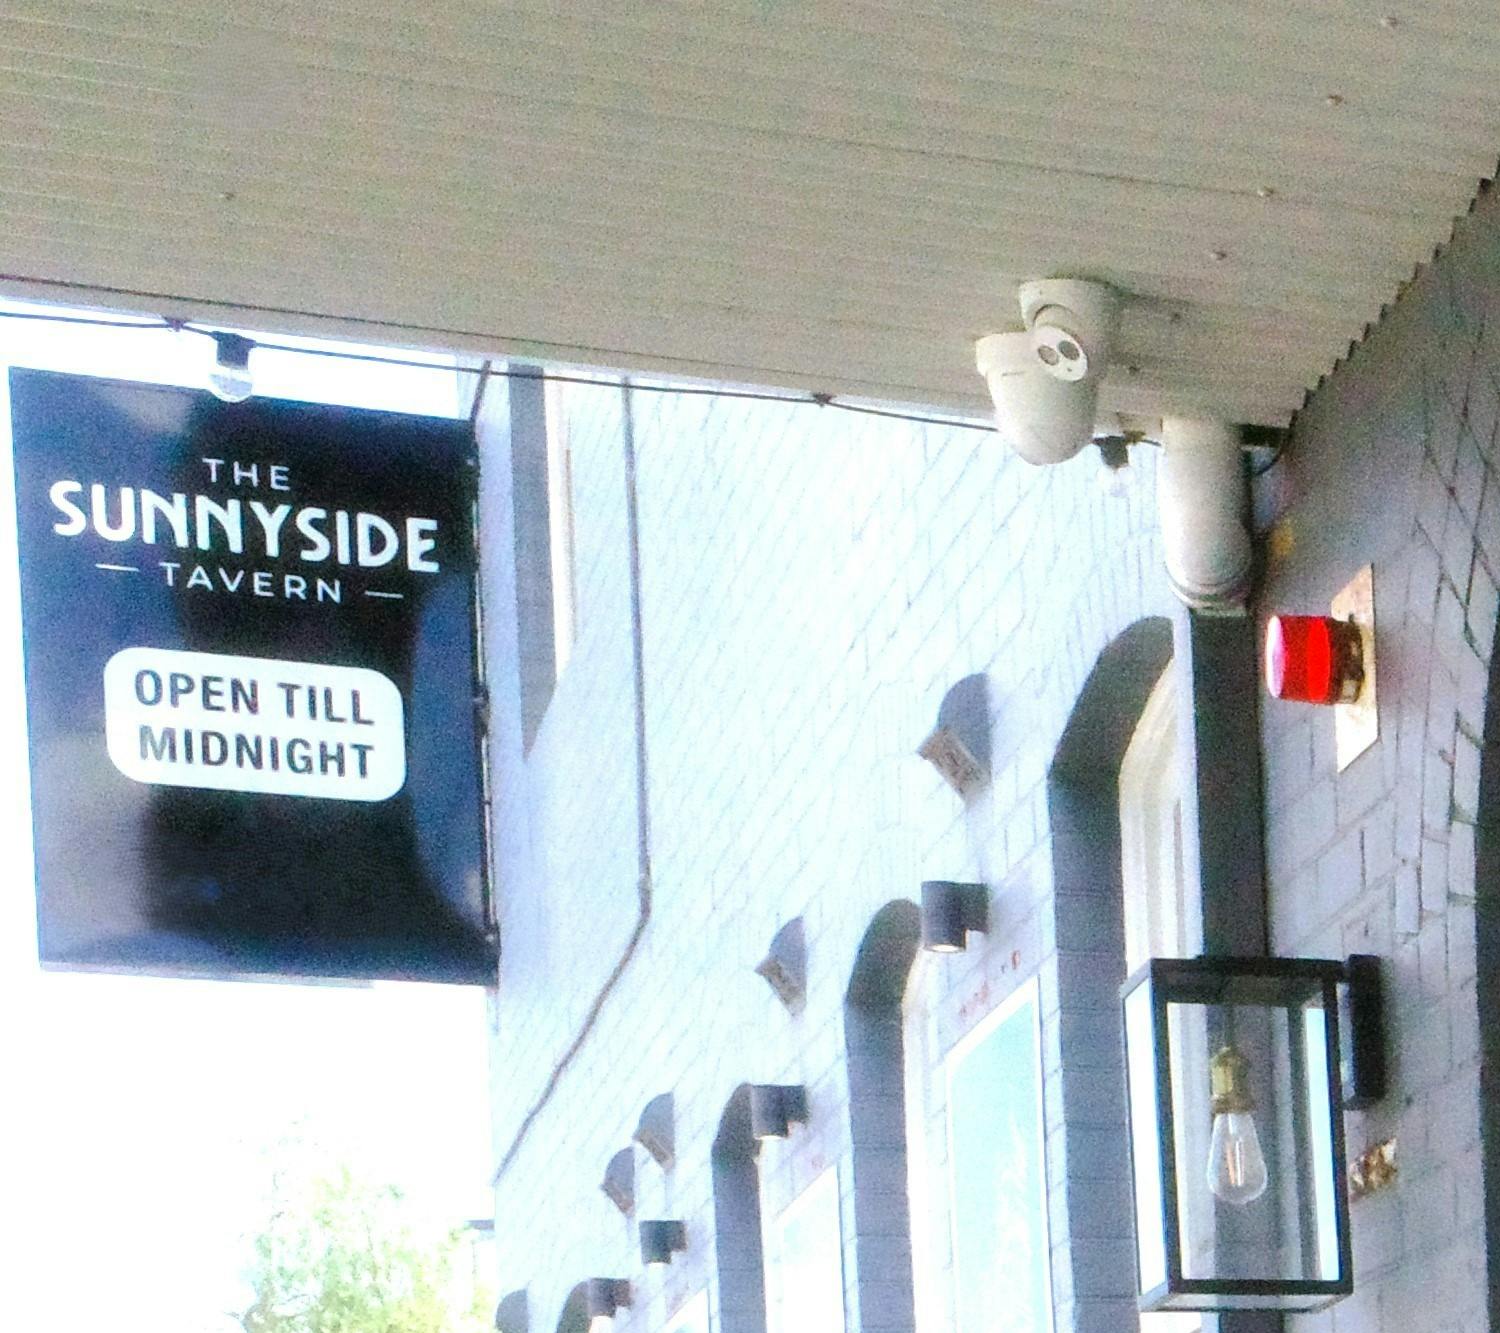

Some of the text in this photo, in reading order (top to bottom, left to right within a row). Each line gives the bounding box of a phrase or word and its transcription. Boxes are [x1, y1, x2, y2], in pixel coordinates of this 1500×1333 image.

[202, 457, 291, 491] THE
[49, 480, 440, 574] SUNNYSIDE
[159, 561, 342, 603] TAVERN
[134, 669, 376, 726] OPEN TILL
[138, 725, 376, 779] MIDNIGHT
